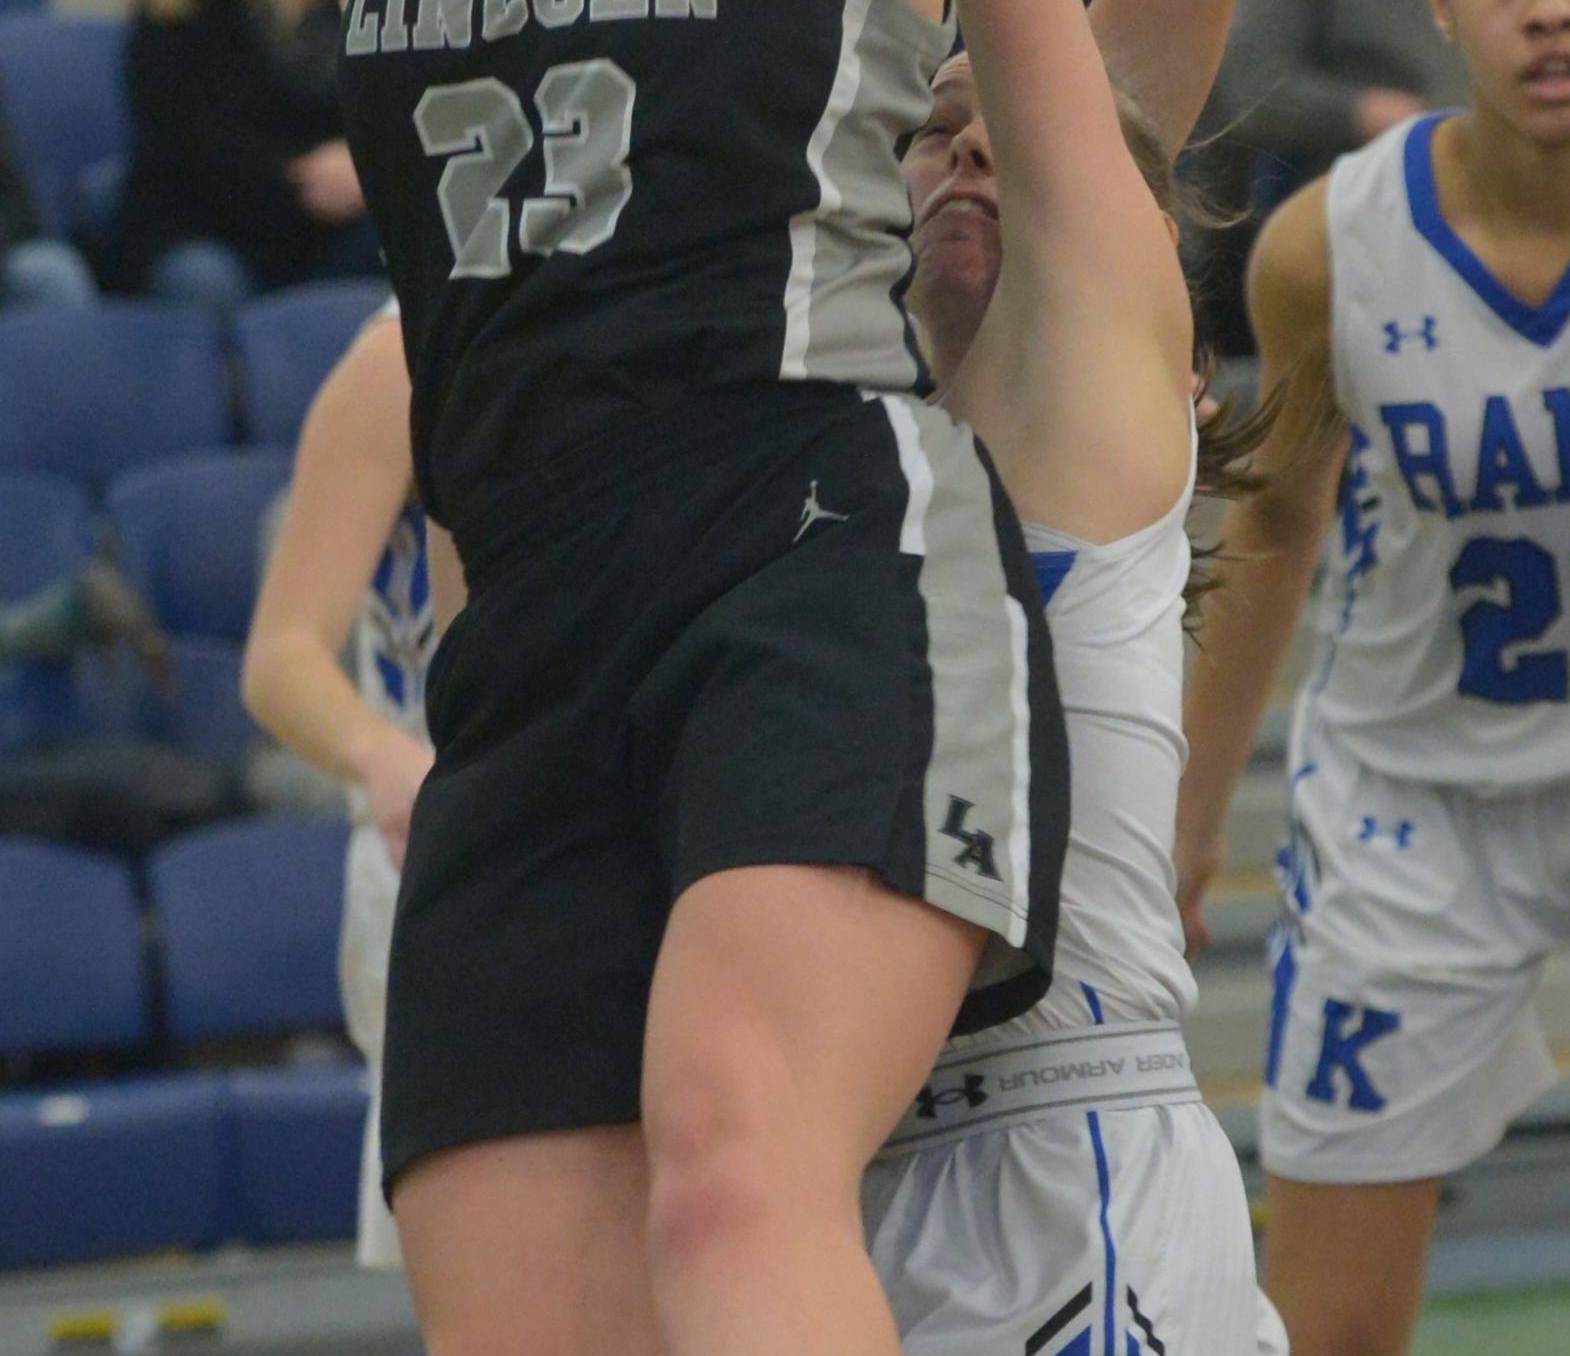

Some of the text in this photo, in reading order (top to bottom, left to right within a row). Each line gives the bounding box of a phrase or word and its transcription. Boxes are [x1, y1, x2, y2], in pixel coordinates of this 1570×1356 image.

[412, 56, 637, 281] 23
[1449, 535, 1570, 708] 2
[938, 793, 1004, 882] LA
[1000, 1052, 1186, 1092] NDER ARMOUR
[1305, 997, 1400, 1113] K
